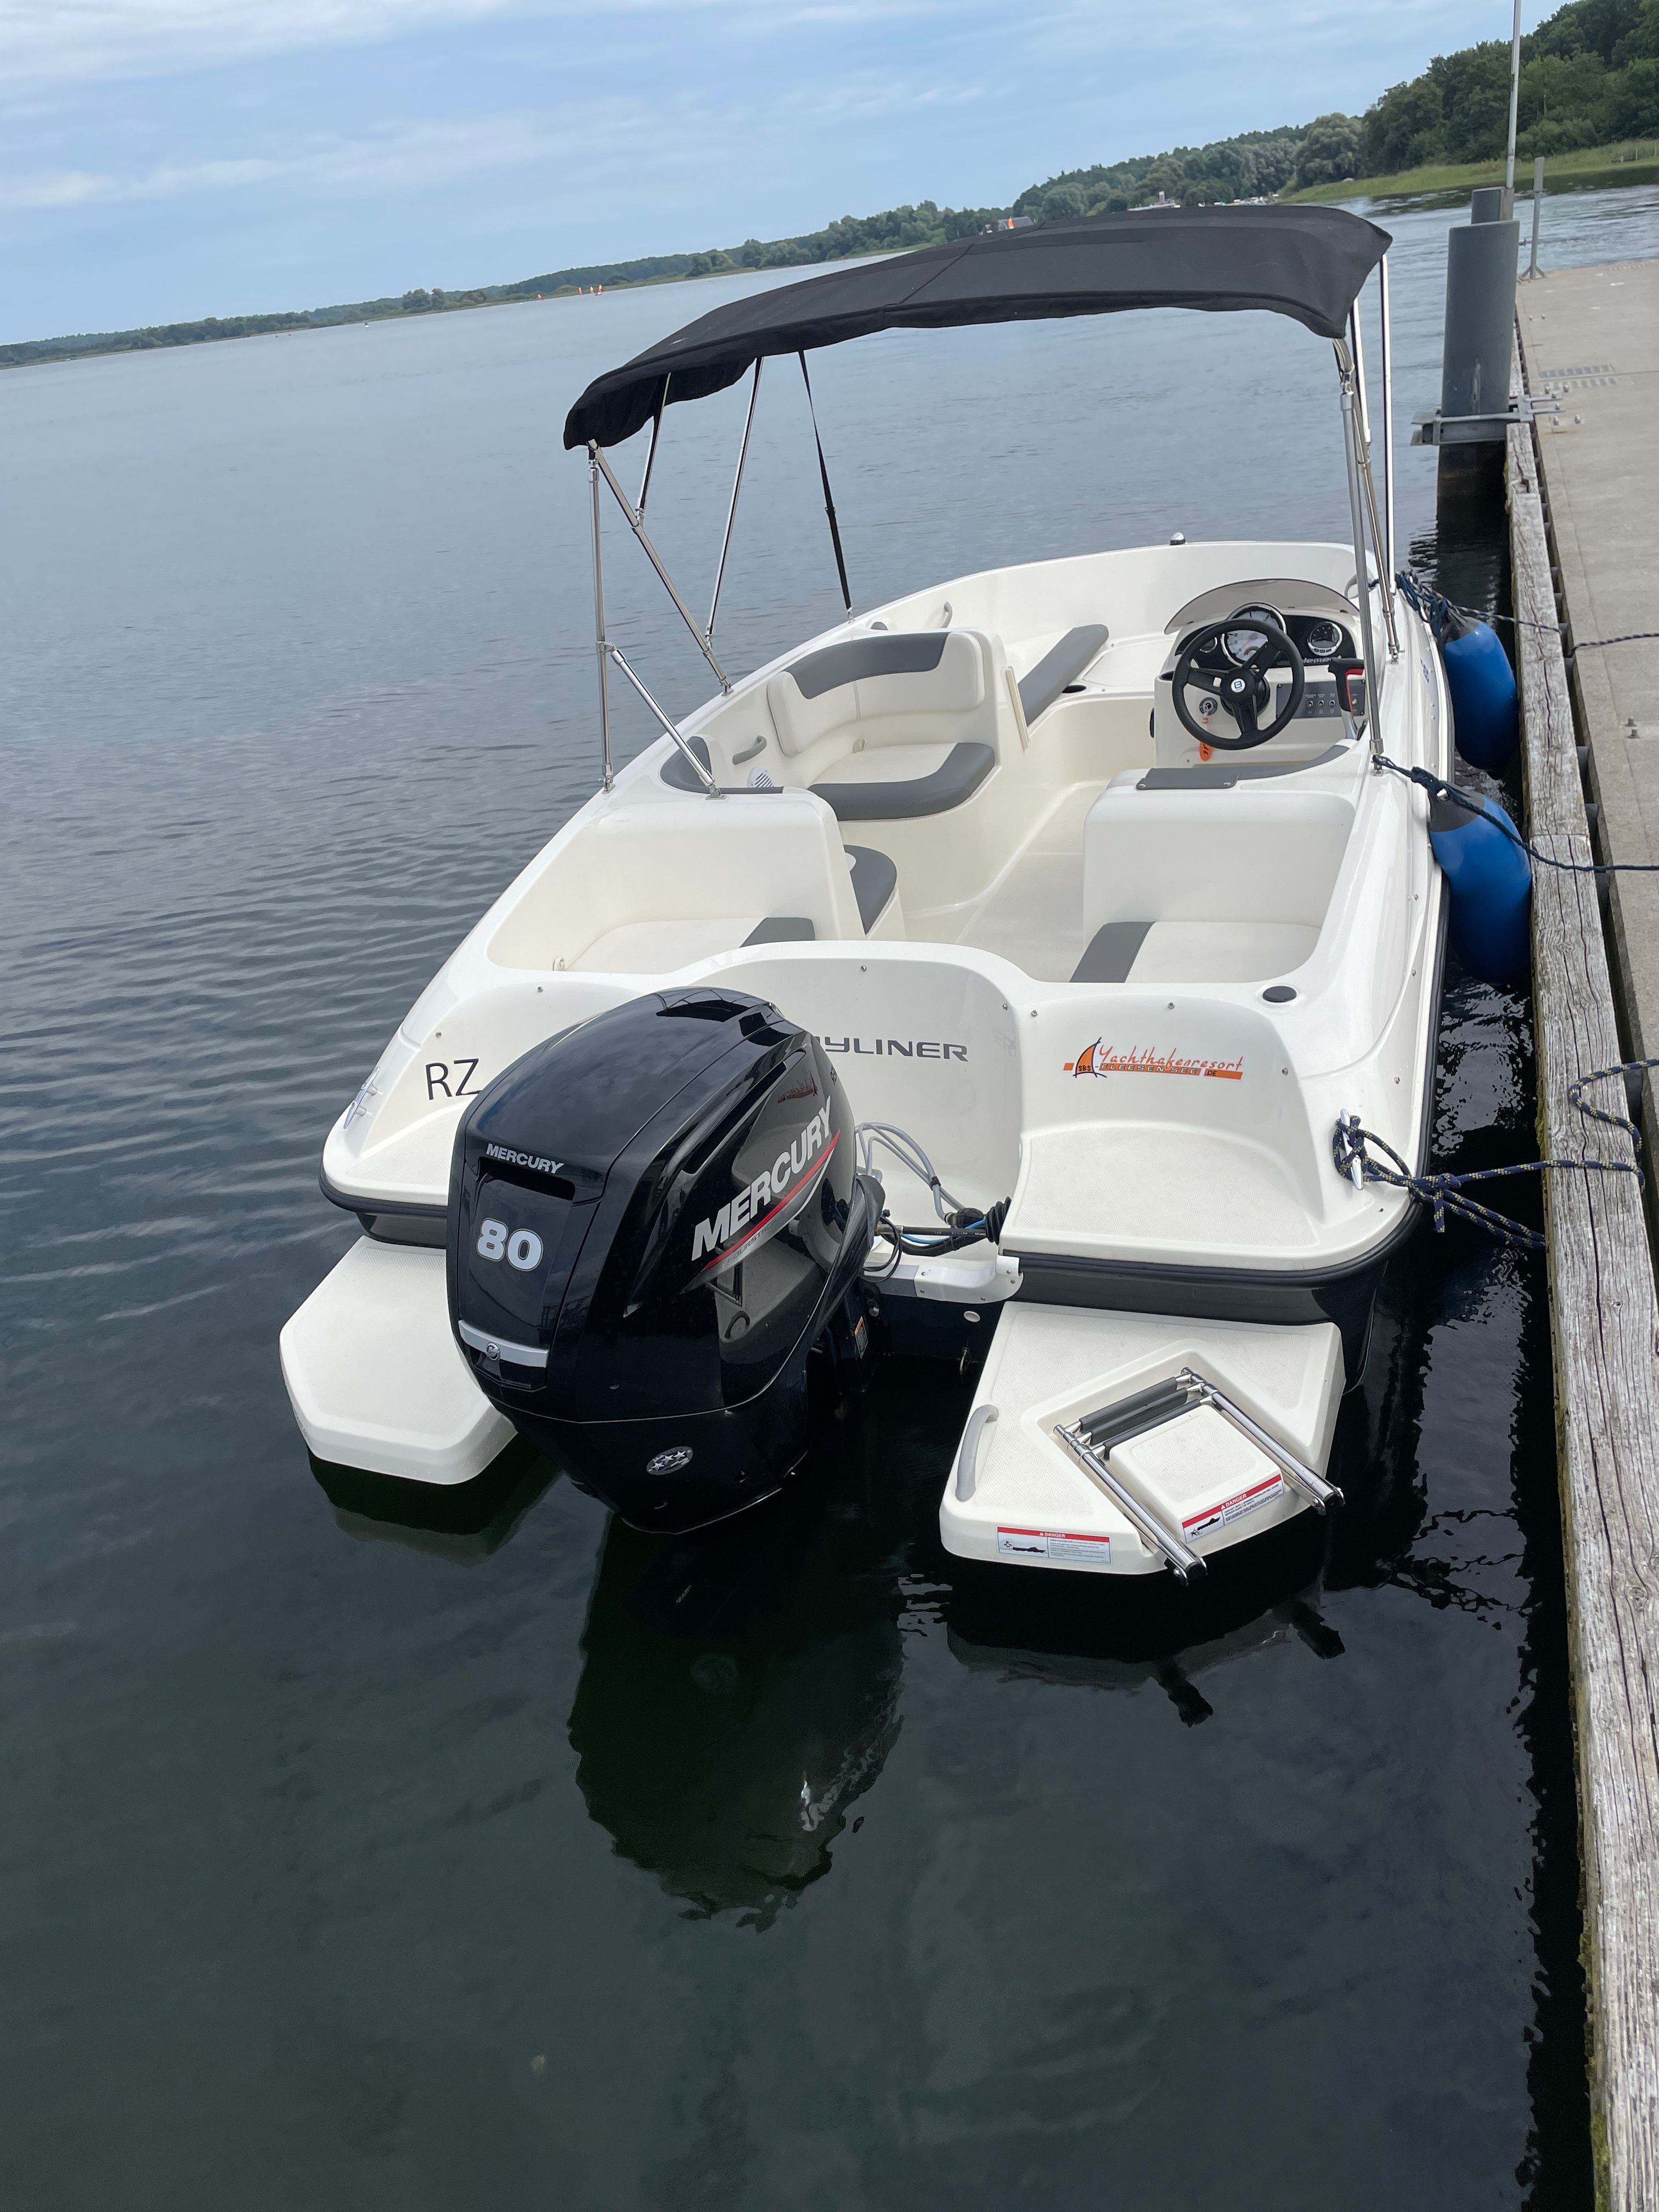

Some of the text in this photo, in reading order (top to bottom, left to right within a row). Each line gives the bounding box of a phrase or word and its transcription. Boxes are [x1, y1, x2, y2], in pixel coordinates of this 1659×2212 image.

[814, 1036, 969, 1062] YLINER
[1099, 1044, 1243, 1070] Yachthafenresort
[425, 1058, 483, 1100] RZ
[486, 1143, 564, 1174] MERCURY
[691, 1095, 830, 1261] MERCURY
[477, 1217, 544, 1272] 80
[1226, 1493, 1247, 1507] DANGER
